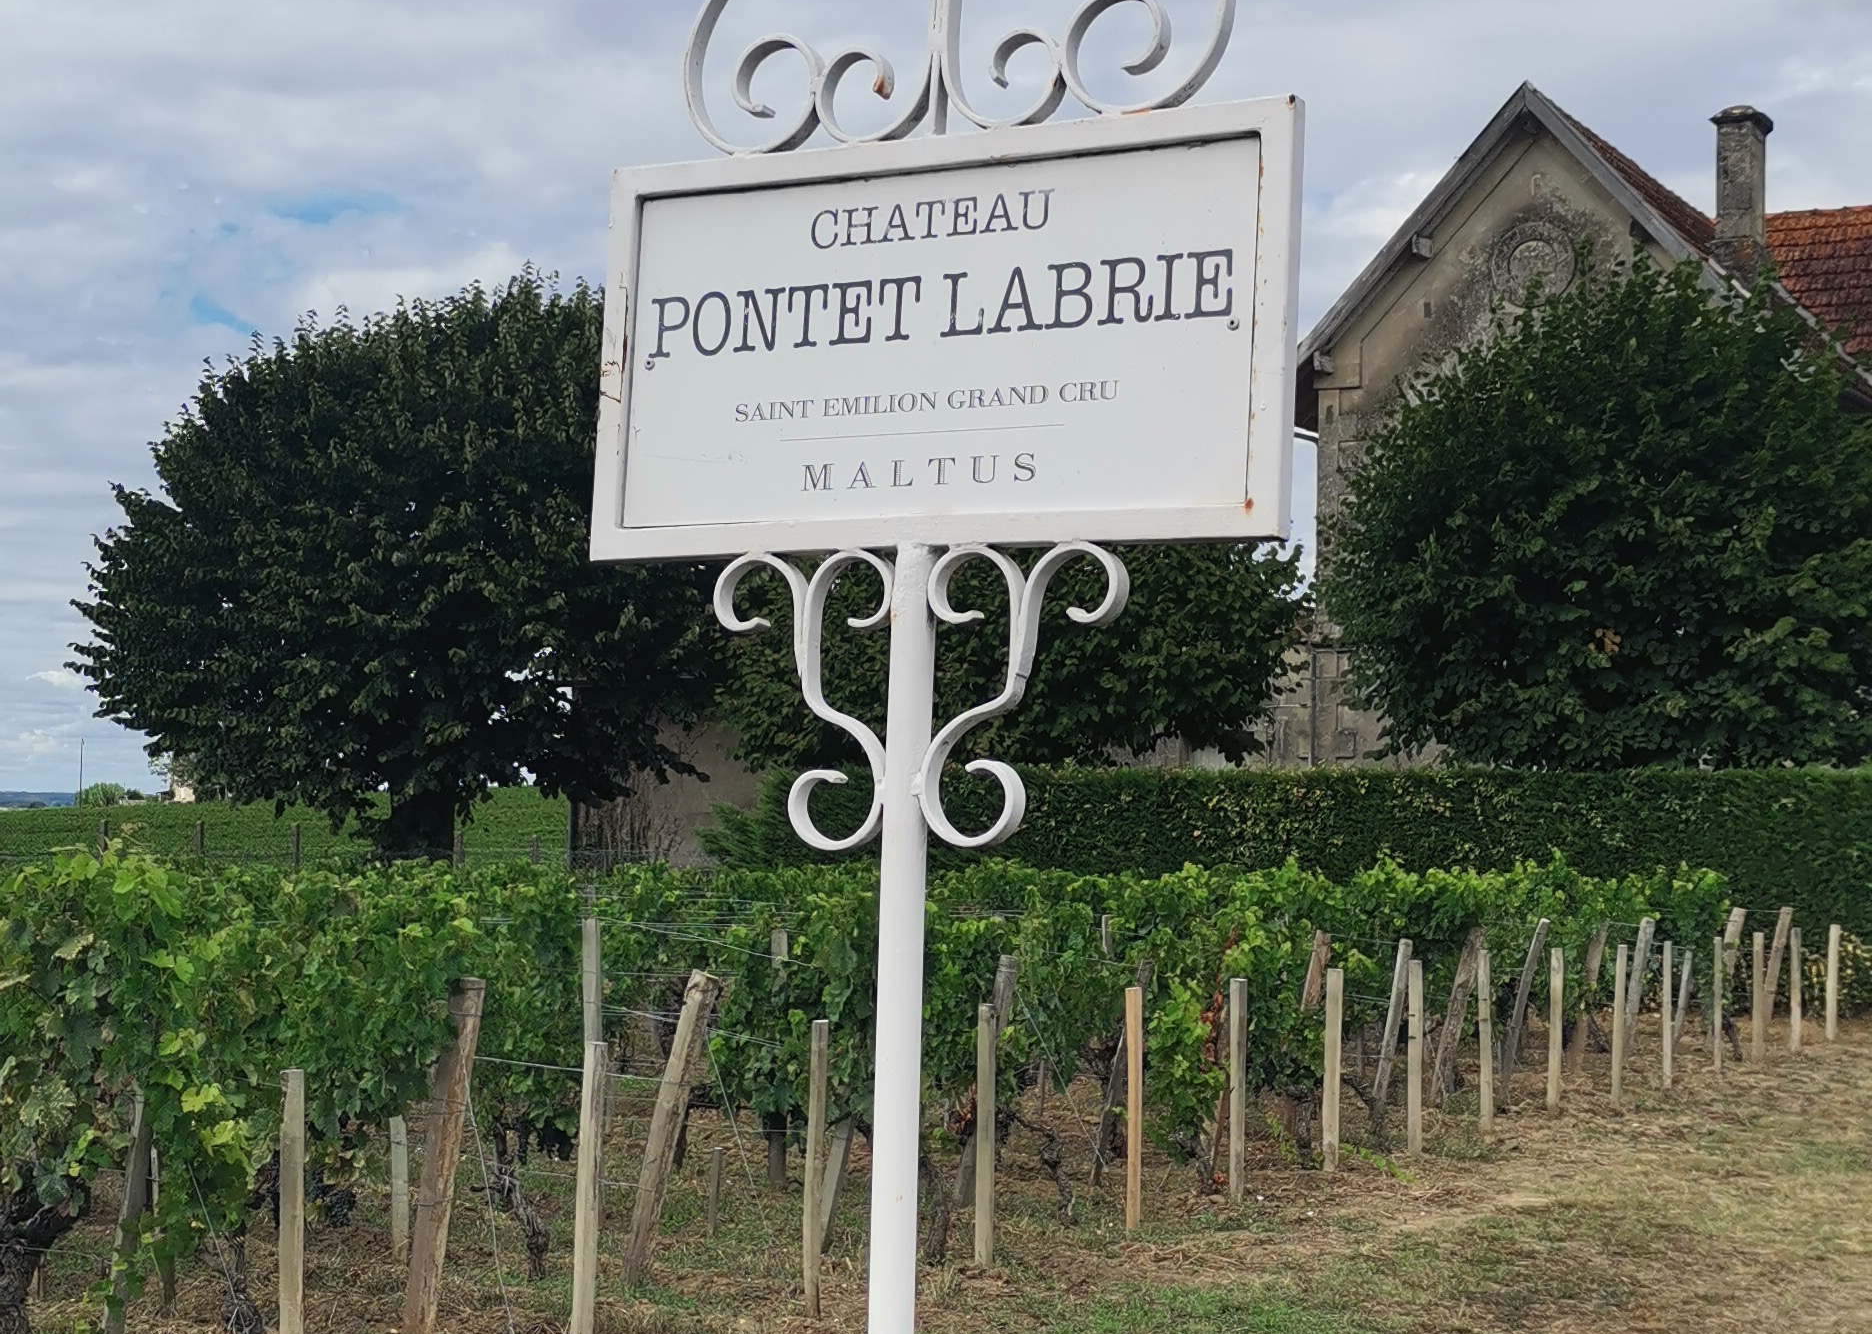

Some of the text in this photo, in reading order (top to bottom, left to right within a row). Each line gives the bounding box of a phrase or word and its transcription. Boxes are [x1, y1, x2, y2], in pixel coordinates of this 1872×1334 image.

[811, 188, 1056, 250] CHATEAU
[648, 248, 1234, 359] PONTET LABRIE
[734, 379, 1120, 423] SAINT EMILION GRAND CRU
[801, 452, 1037, 492] MALTUS
